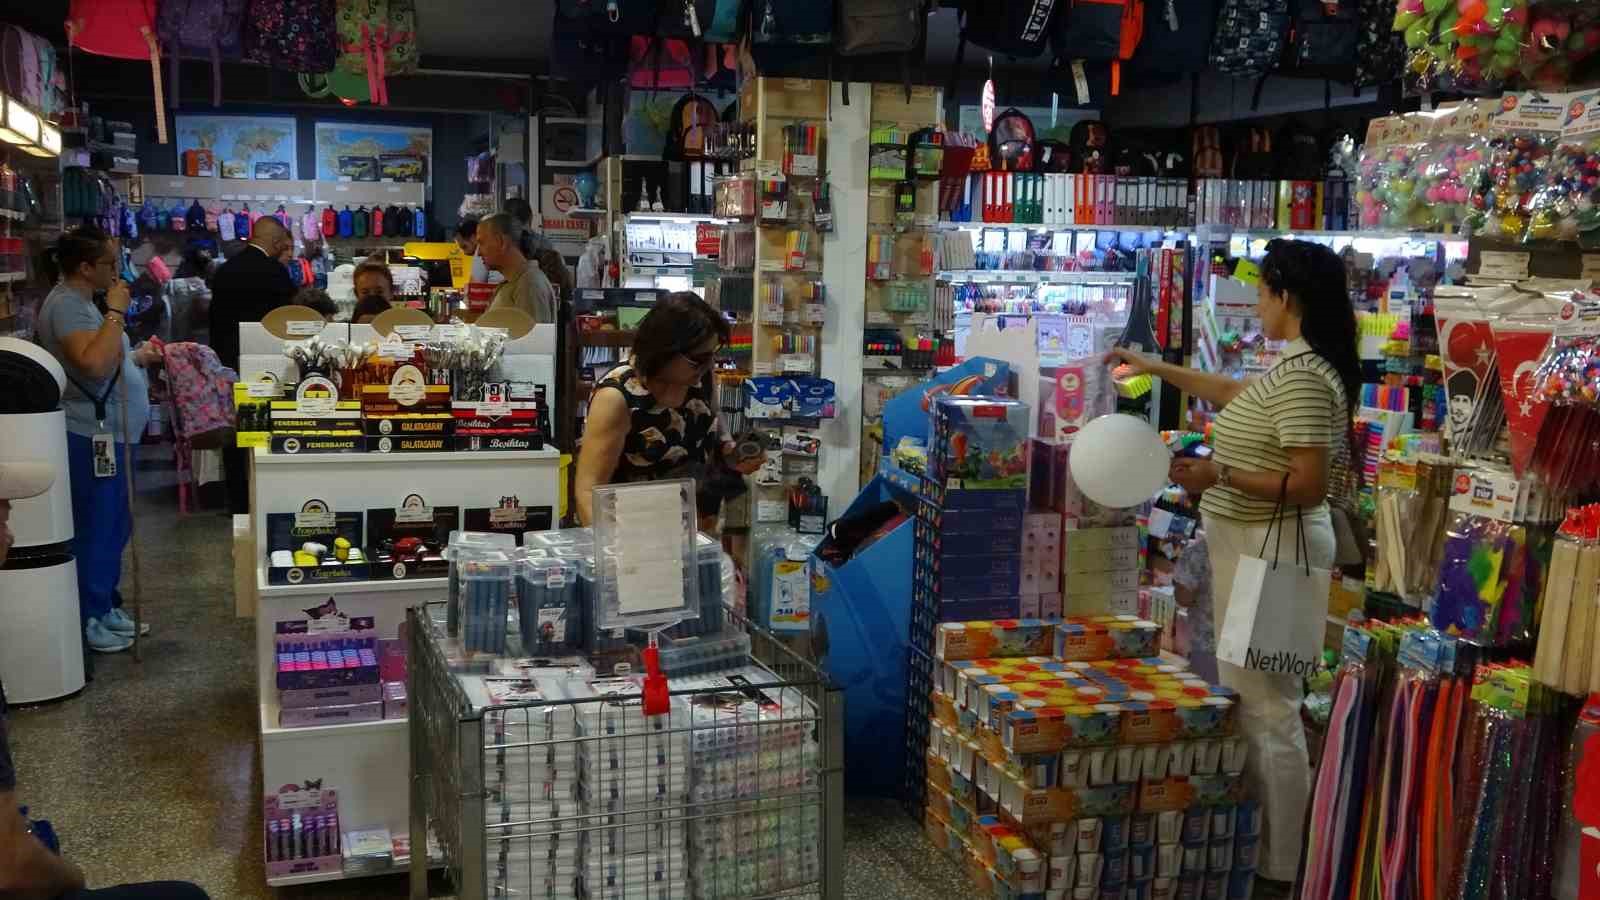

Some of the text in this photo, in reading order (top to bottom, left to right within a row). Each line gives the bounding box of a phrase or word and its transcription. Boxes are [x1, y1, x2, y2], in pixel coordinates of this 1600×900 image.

[401, 422, 444, 432] GALATASARAY
[401, 440, 444, 449] GALATASARAY
[1244, 648, 1320, 678] NetWork
